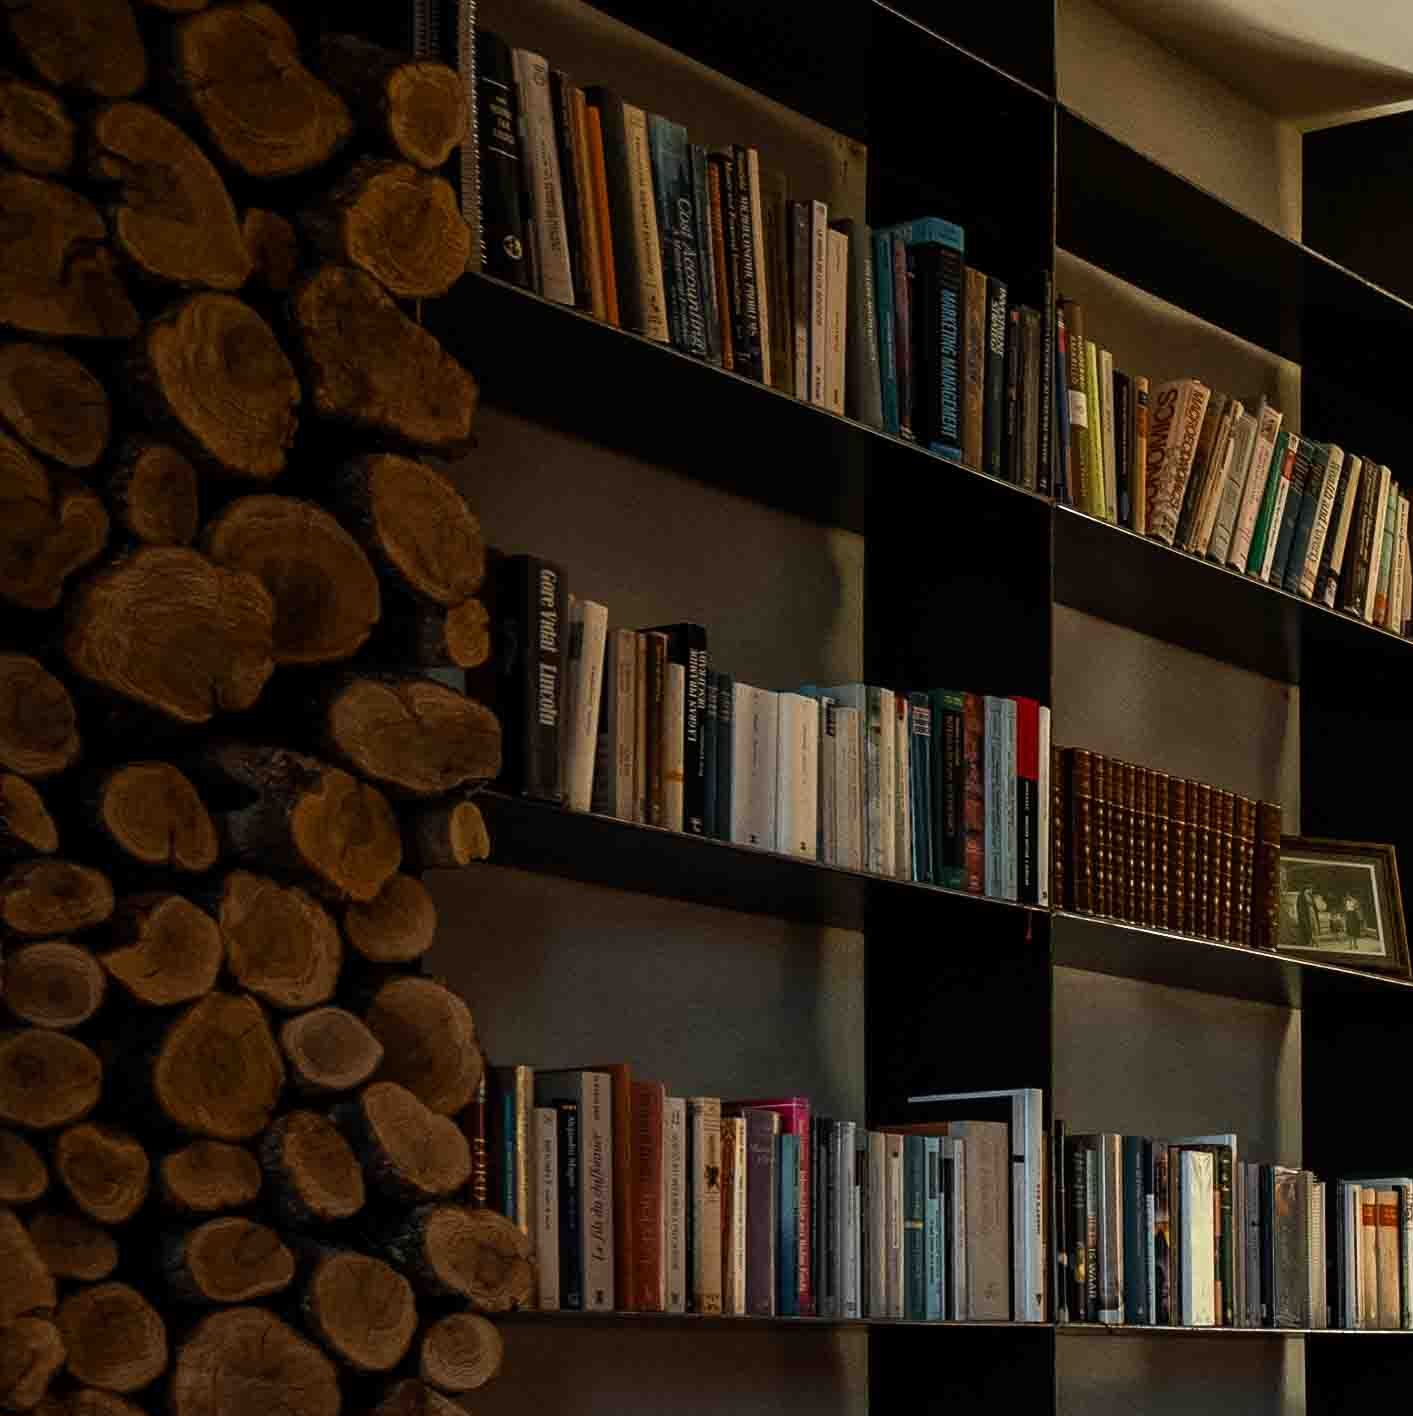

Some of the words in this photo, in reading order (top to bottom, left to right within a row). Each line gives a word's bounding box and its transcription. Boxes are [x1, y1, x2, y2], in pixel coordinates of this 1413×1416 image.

[942, 288, 958, 355] MARKETING
[942, 358, 958, 439] MANAGEMENT
[539, 568, 558, 608] Gore
[539, 610, 558, 652] Vidal
[538, 662, 558, 727] Lincoln
